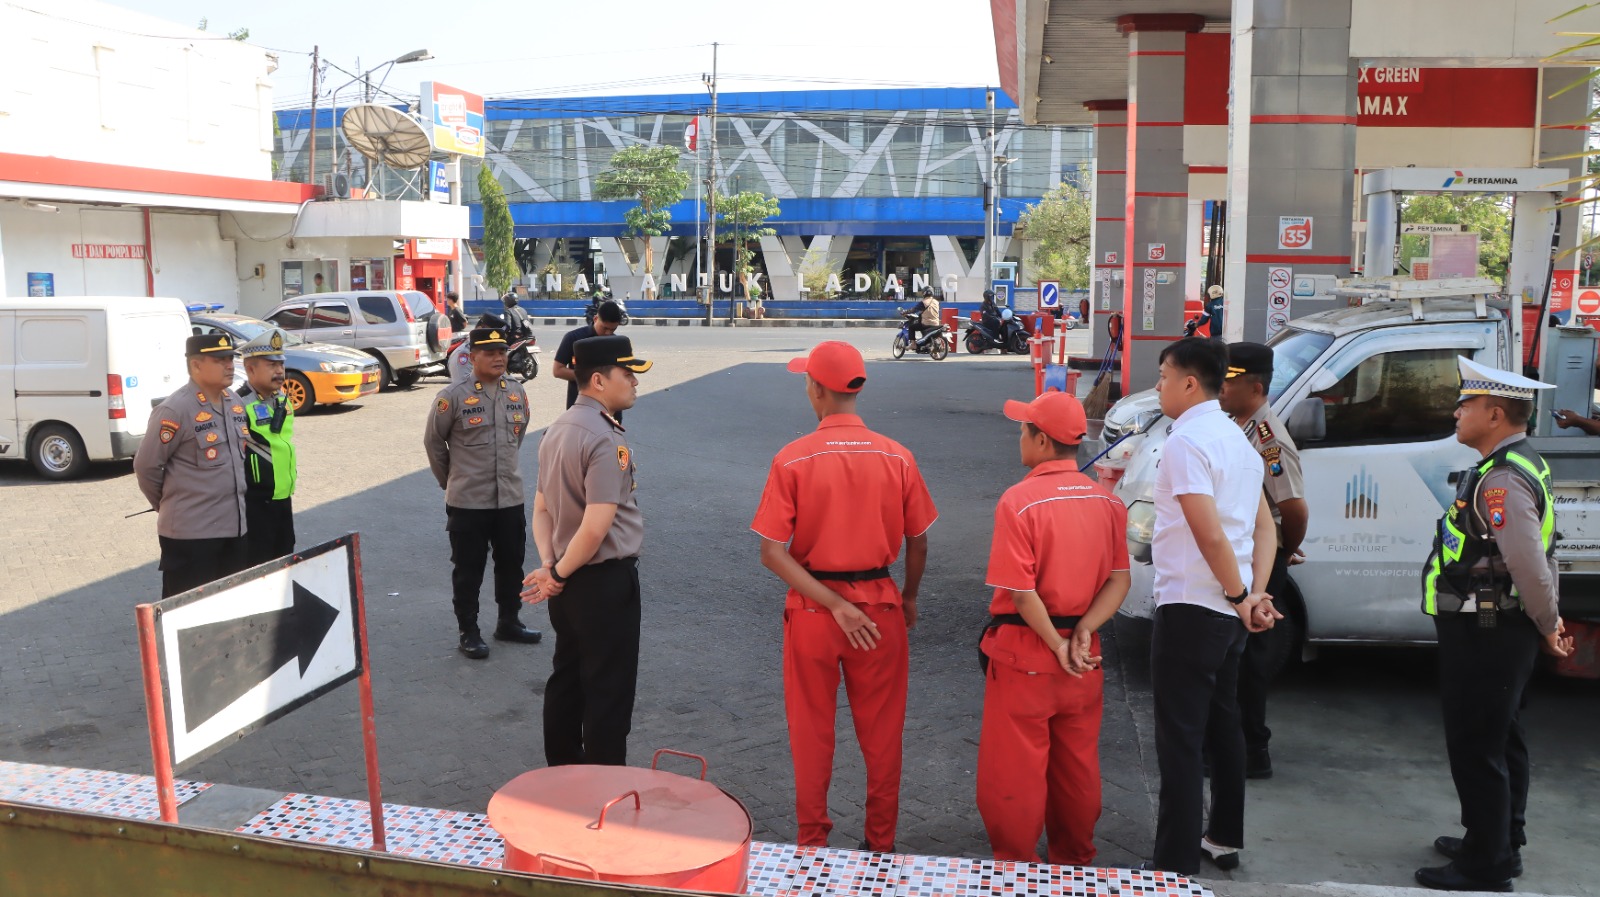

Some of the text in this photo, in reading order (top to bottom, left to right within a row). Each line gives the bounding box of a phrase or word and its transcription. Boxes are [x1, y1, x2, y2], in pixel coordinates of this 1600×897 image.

[1375, 68, 1420, 83] GREEN
[1467, 177, 1518, 185] PERTAMINA
[89, 245, 103, 258] DAN
[105, 245, 130, 258] POMPA
[131, 245, 144, 258] BAN
[449, 273, 611, 292] RINAL
[797, 273, 958, 293] LADANG
[462, 406, 486, 415] PARDI
[1553, 495, 1578, 504] iture
[1328, 545, 1388, 553] FURNITURE
[1335, 569, 1422, 577] WWW.OLYMPICFUR
